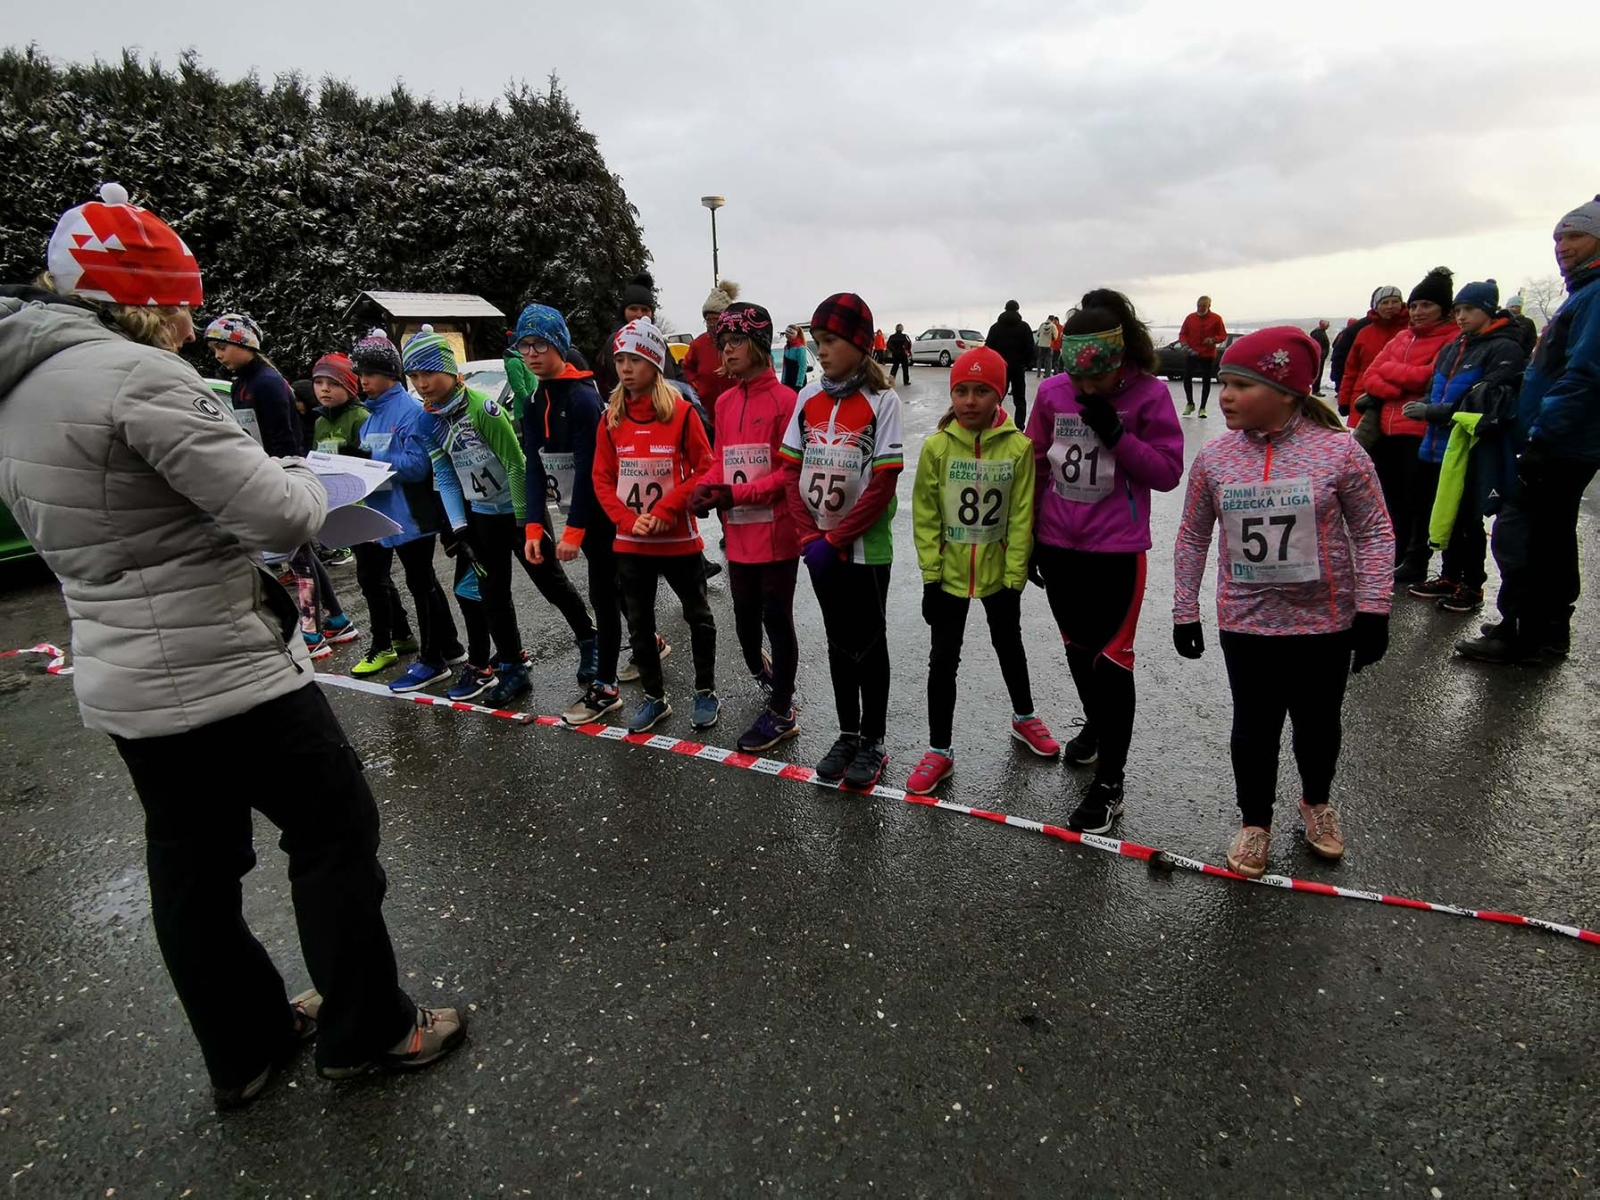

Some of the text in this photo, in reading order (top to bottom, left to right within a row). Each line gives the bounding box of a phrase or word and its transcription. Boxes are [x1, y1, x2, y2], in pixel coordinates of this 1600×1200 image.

[1056, 417, 1079, 427] ZIMNÍ
[1055, 427, 1089, 438] BĚŽECKÁ
[806, 447, 826, 456] ZIMNÍ
[749, 456, 769, 464] LIGA
[804, 455, 834, 467] BĚŽECKÁ
[838, 460, 858, 469] LIGA
[950, 460, 978, 471] ZIMNÍ
[1061, 443, 1100, 486] 81
[557, 463, 576, 471] LIGA
[652, 468, 672, 477] LIGA
[470, 466, 502, 498] 41
[949, 470, 1013, 482] BĚŽECKÁ LIGA
[625, 482, 664, 515] 42
[807, 472, 846, 513] 55
[1223, 486, 1257, 499] ZIMNÍ
[957, 486, 1003, 526] 82
[1222, 494, 1311, 511] BĚŽECKÁ LIGA
[1241, 514, 1297, 564] 57
